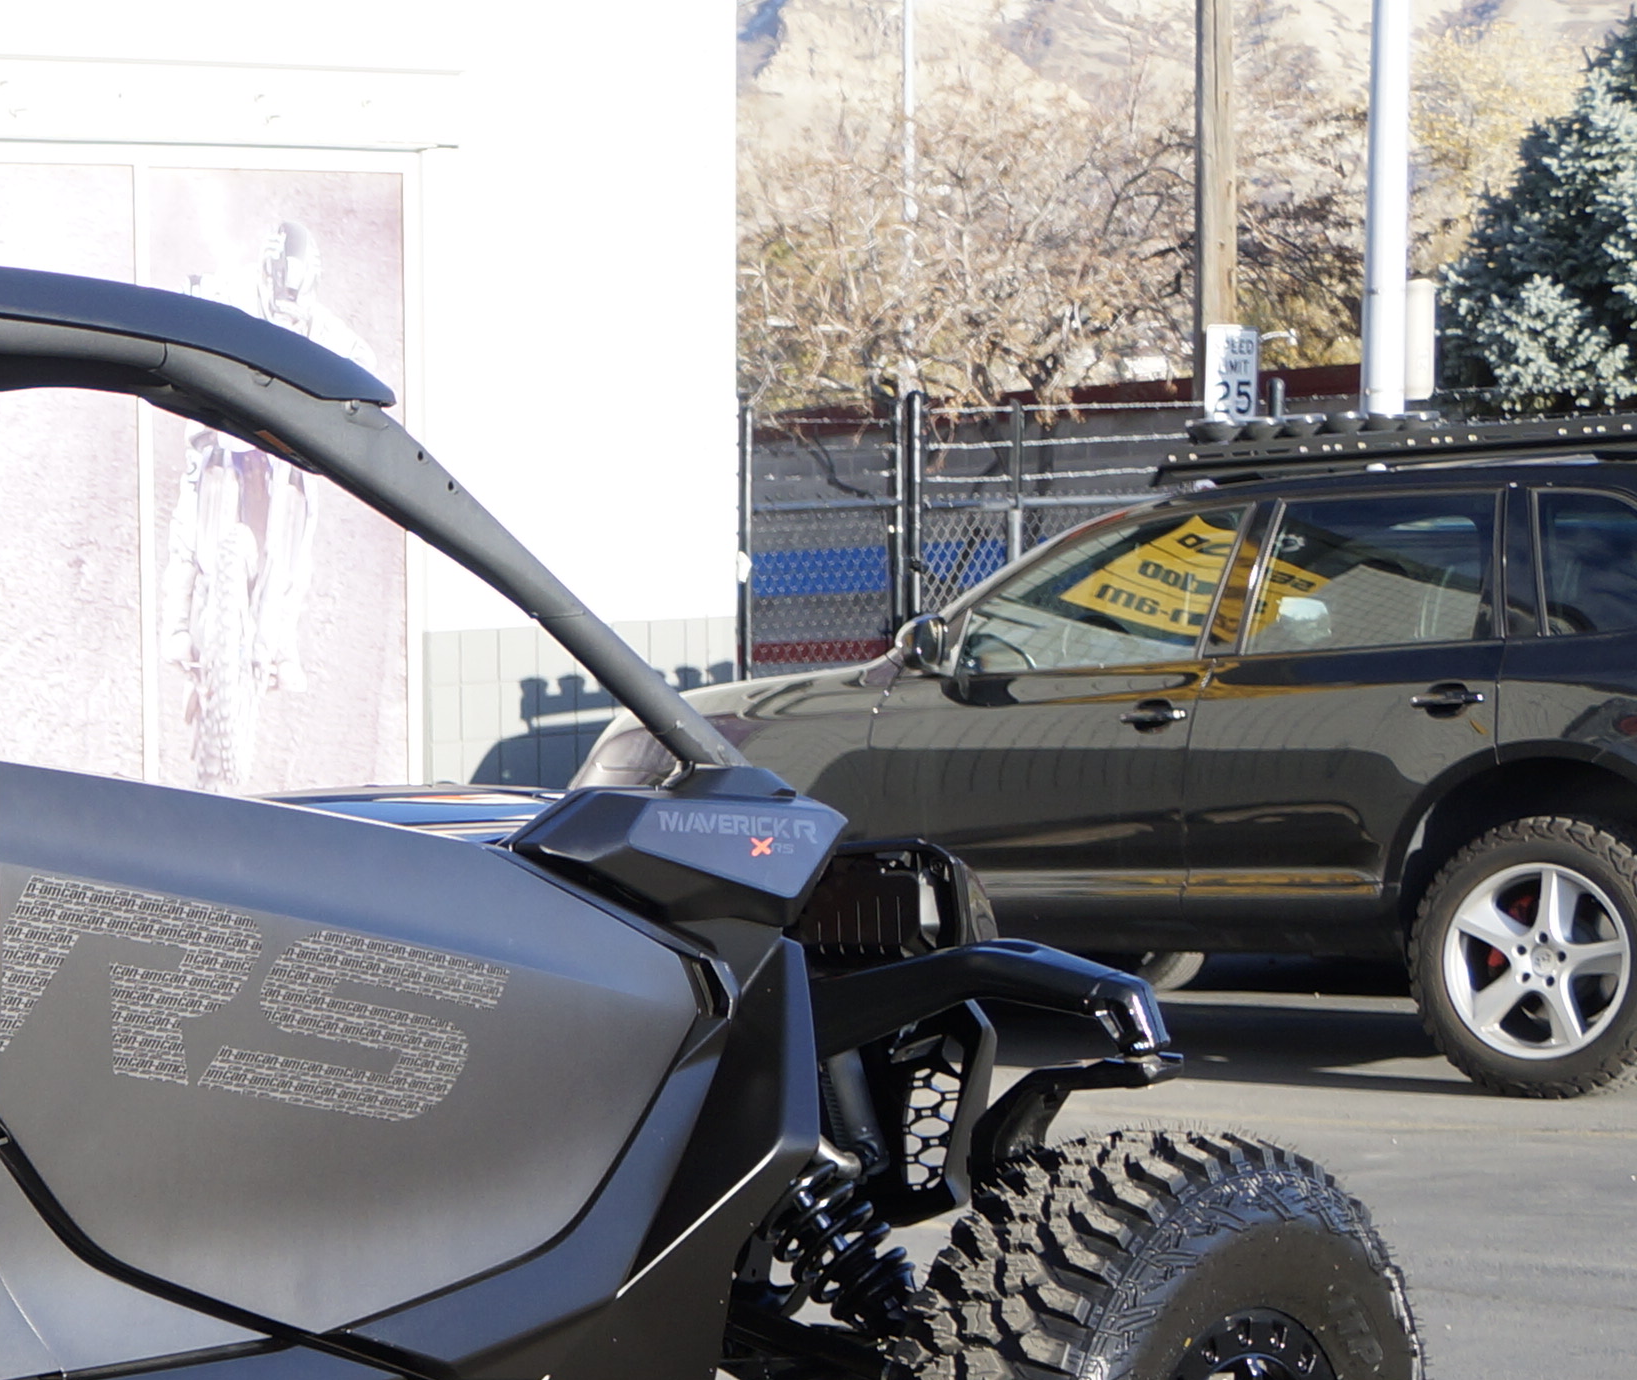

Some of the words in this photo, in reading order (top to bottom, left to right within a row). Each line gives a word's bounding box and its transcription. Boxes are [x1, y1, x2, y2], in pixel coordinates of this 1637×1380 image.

[1215, 381, 1252, 414] 25
[657, 811, 790, 838] MAVERICK
[793, 819, 817, 844] R
